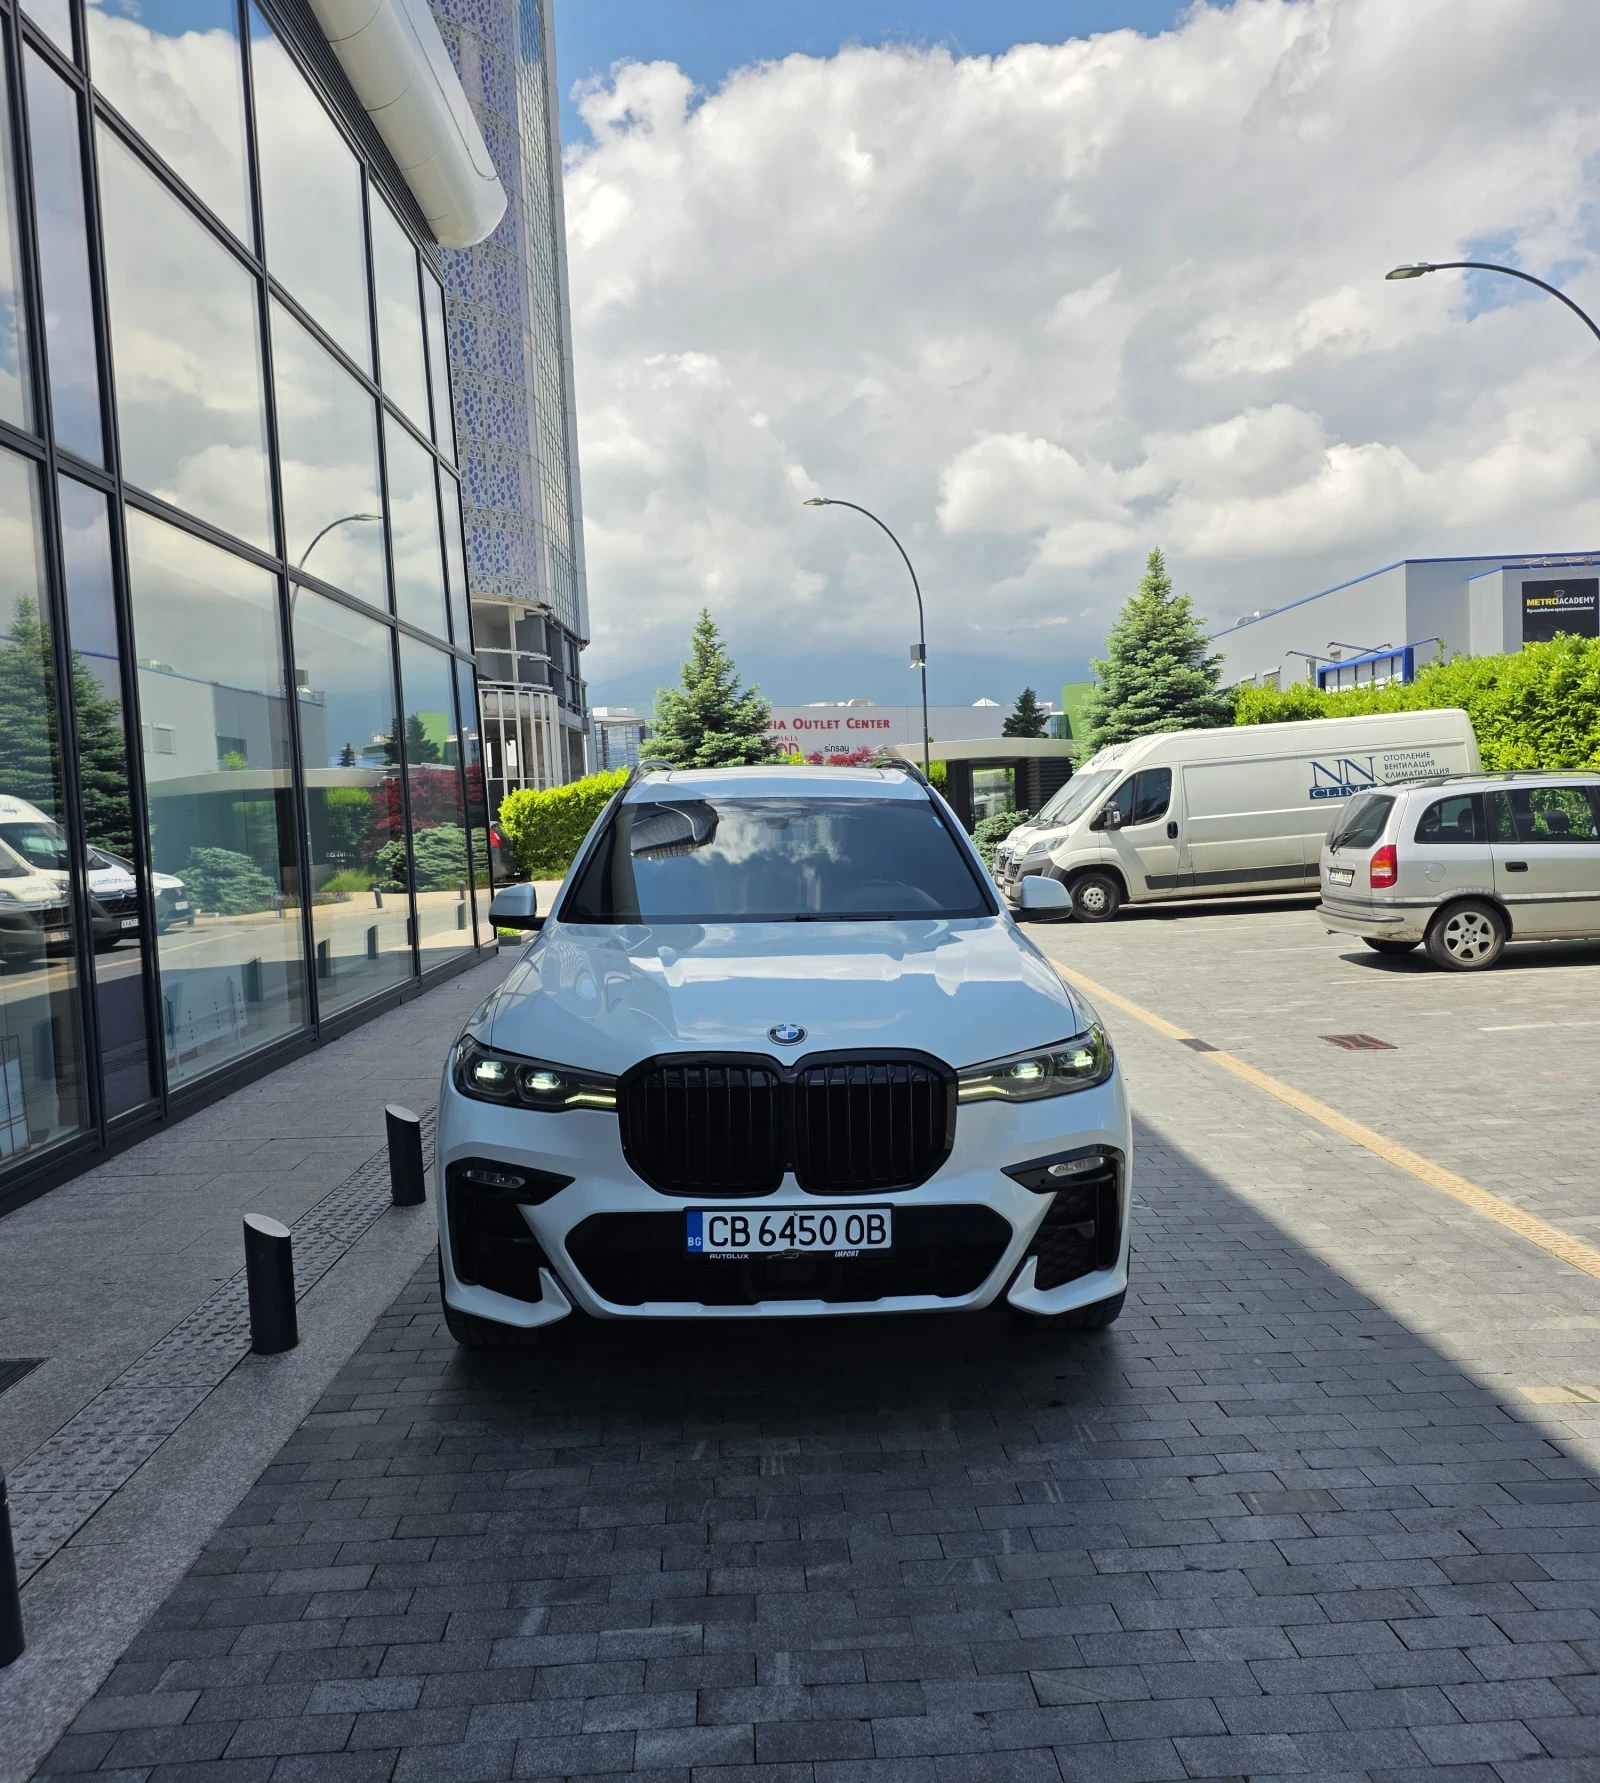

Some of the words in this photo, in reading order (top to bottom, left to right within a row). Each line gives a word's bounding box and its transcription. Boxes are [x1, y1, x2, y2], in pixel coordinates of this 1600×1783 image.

[824, 743, 850, 754] sinsay
[1383, 751, 1431, 762] ОТОПЛЕНИЕ
[1384, 760, 1435, 771] ВЕНТИЛАЦИЯ
[1308, 755, 1376, 789] NN
[1385, 767, 1450, 779] КЛИМАТИЗАЦИЯ
[709, 1216, 750, 1247] CB
[758, 1215, 837, 1246] 6450
[845, 1214, 886, 1245] OB
[687, 1236, 702, 1247] BG
[834, 1250, 859, 1258] IMPORT
